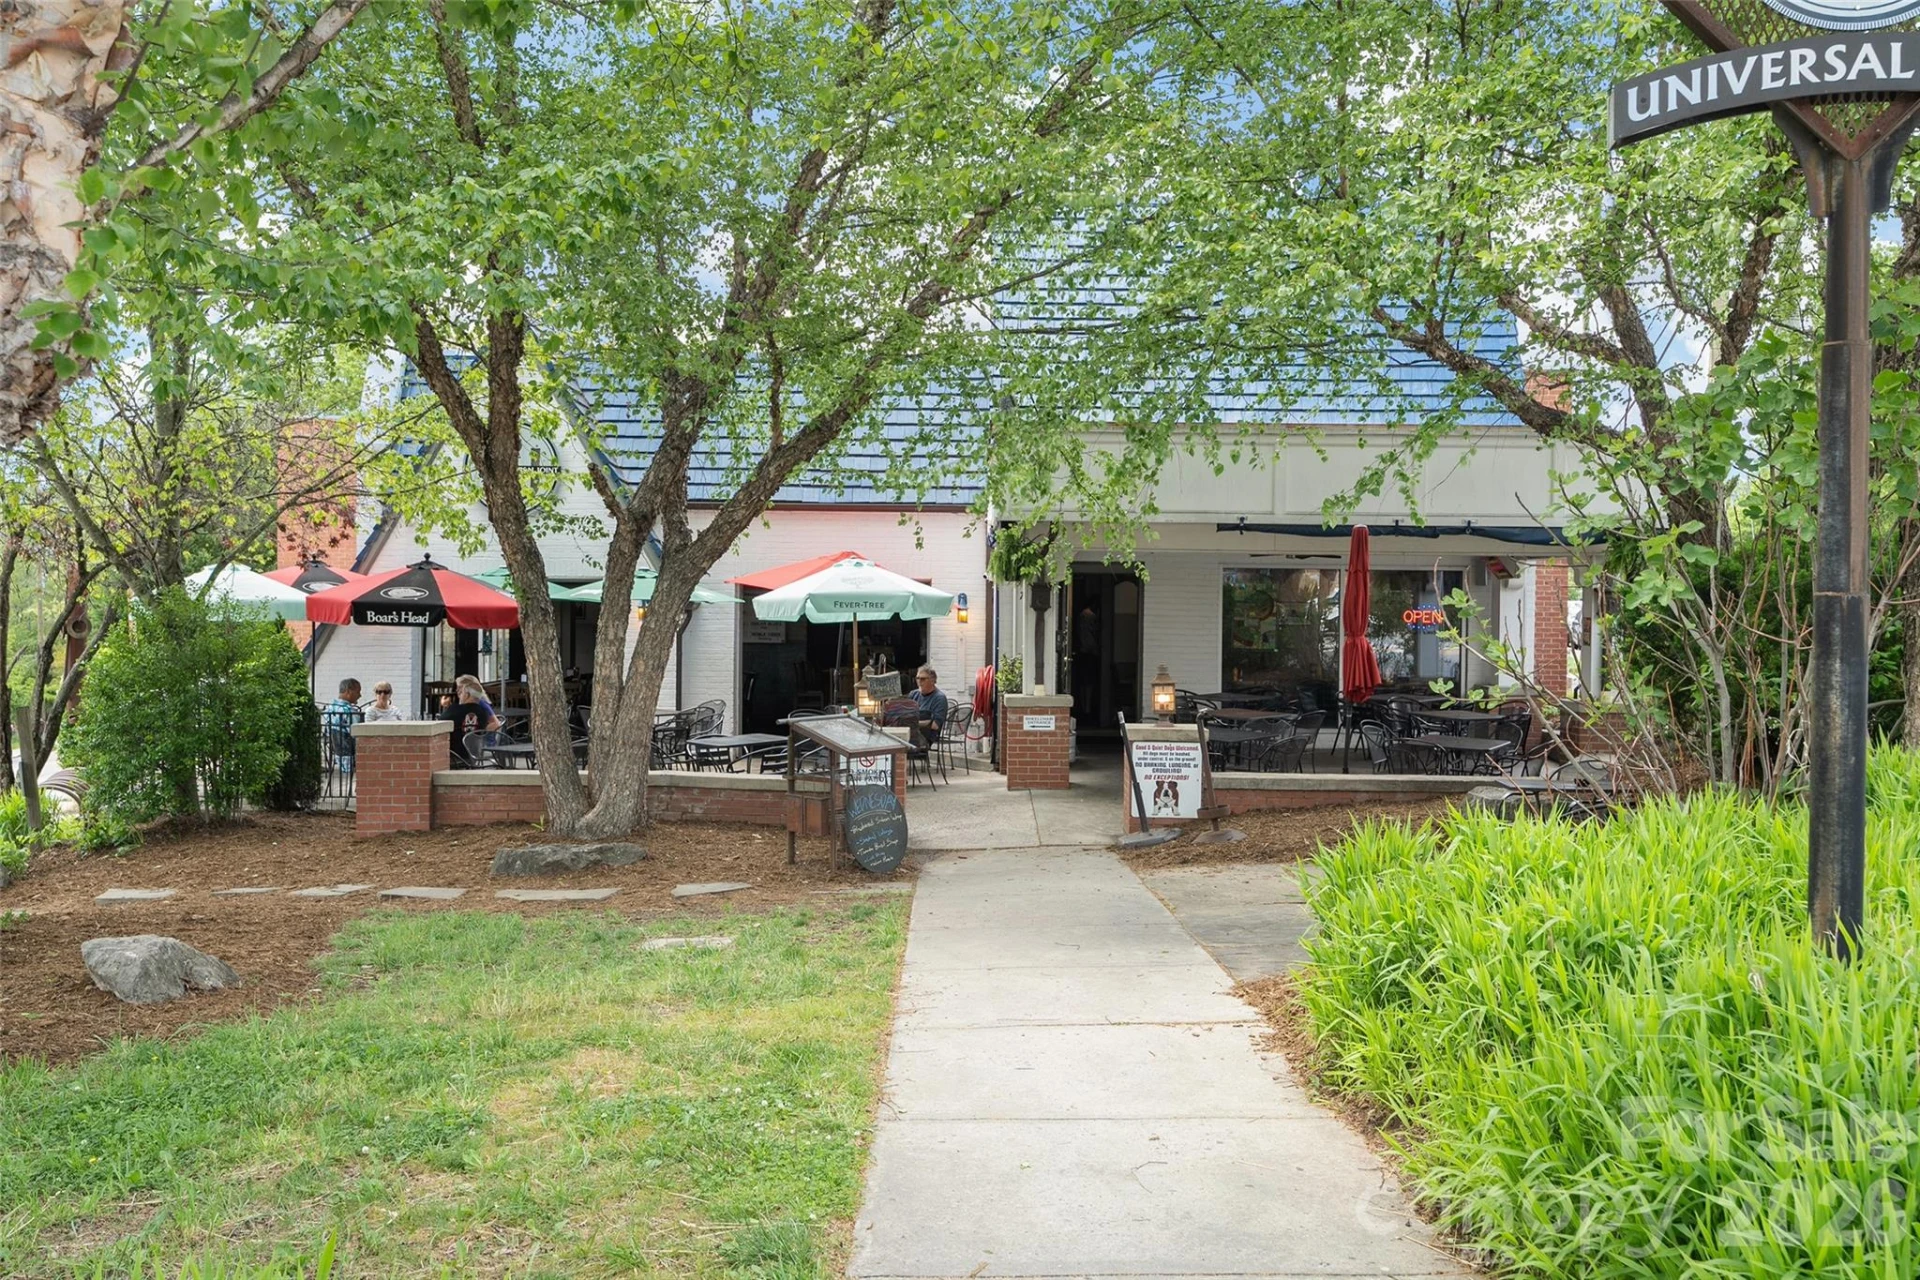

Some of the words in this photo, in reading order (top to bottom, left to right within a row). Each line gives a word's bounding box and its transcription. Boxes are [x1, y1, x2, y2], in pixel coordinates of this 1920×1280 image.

[1627, 42, 1915, 122] UNIVERSAL
[366, 611, 399, 623] Boar's
[401, 611, 430, 624] Head
[1403, 609, 1442, 624] OPEN
[848, 792, 897, 818] WEDNESDAY
